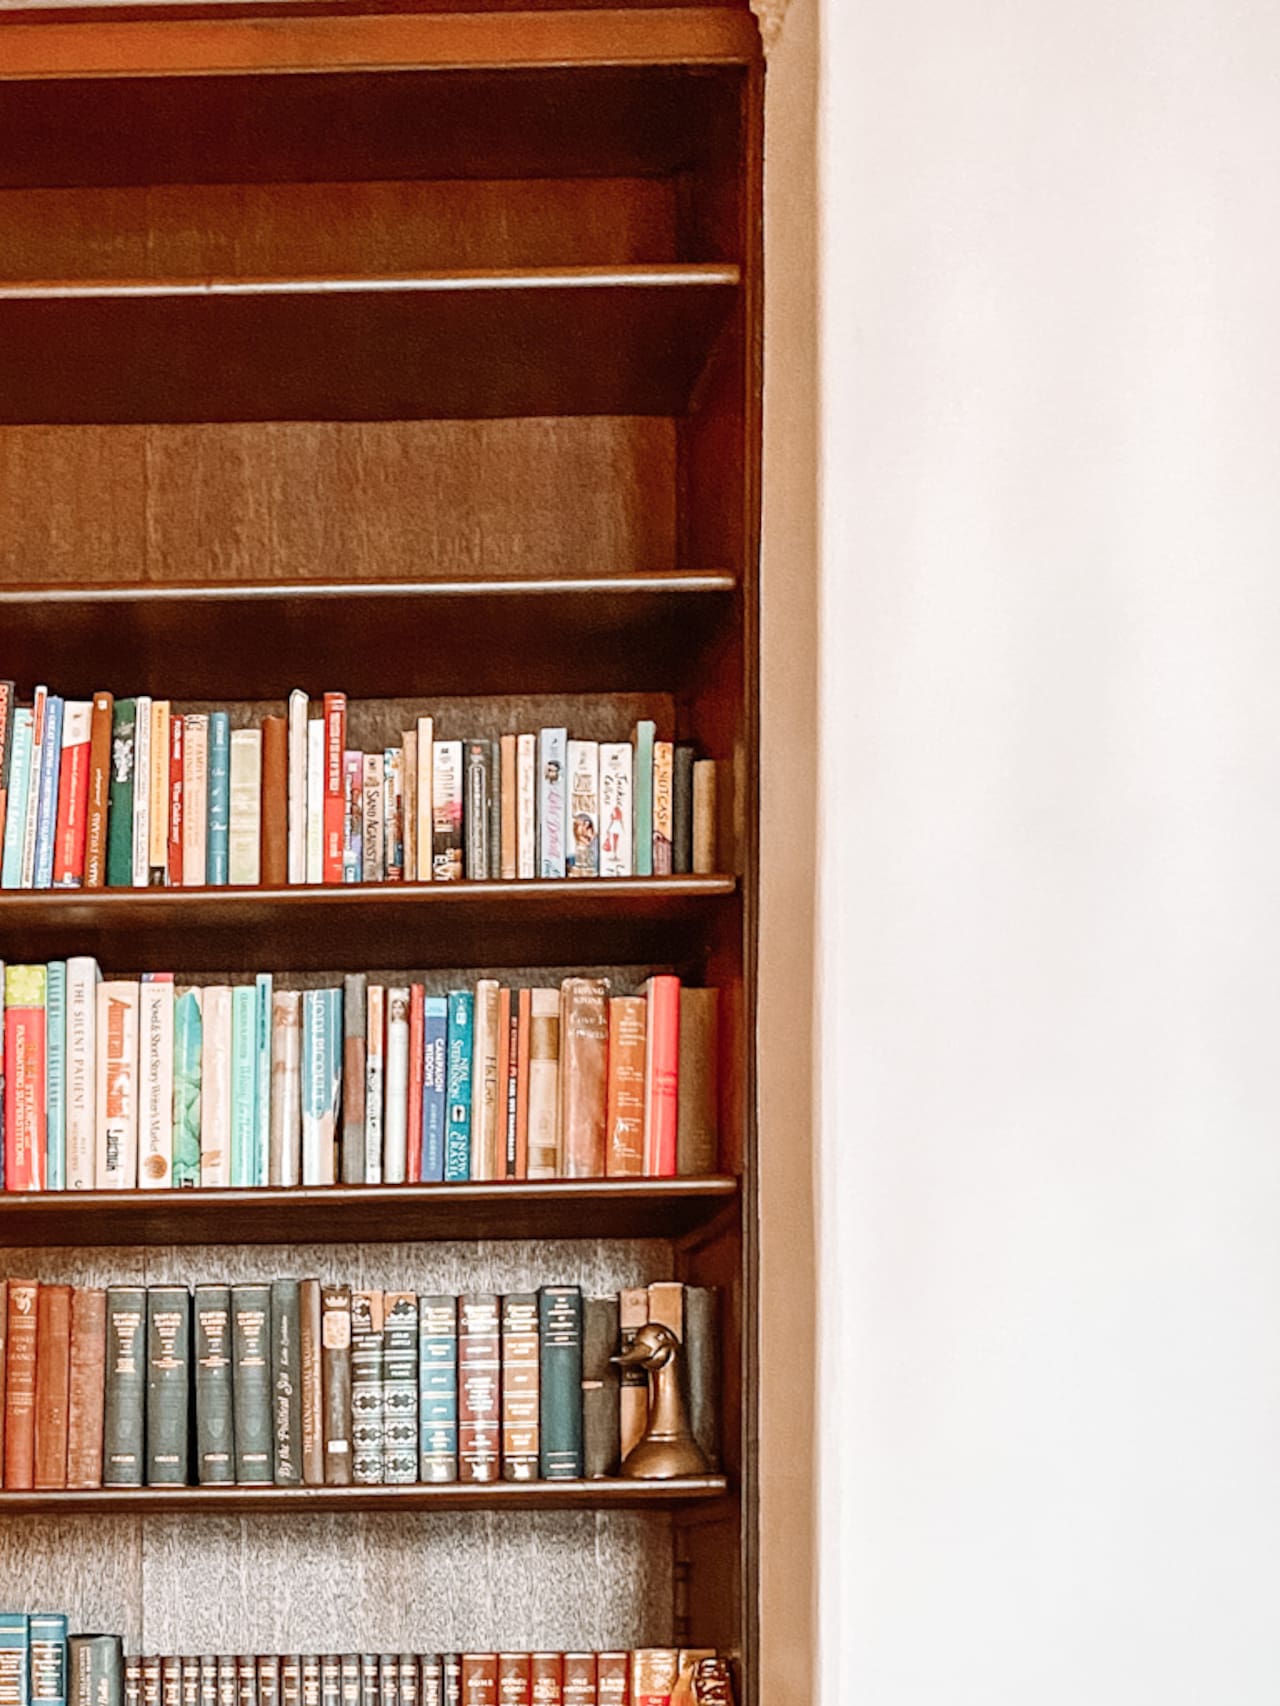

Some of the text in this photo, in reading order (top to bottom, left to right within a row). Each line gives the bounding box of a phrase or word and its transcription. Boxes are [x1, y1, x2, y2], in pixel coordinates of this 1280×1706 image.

[604, 775, 613, 805] Collins
[615, 773, 628, 807] Jackie
[658, 771, 669, 827] NUTCASE
[91, 812, 102, 854] DREAMS
[367, 790, 378, 864] SAND AGAINST
[150, 999, 161, 1024] Novel
[74, 982, 85, 1109] THE SILENT PATIENT
[107, 998, 131, 1118] American Mischief
[150, 1034, 161, 1058] Short
[312, 1000, 324, 1103] JODI PICOULT
[425, 1044, 434, 1087] WIDOWS
[435, 1038, 444, 1092] CAMPAIGN
[149, 1059, 161, 1083] Story
[450, 1040, 463, 1099] STEPHENSON
[460, 1057, 468, 1082] NEAL
[15, 1025, 25, 1166] FASCINATING SUPERSTITIONS
[25, 1084, 34, 1131] STRANGE
[150, 1085, 161, 1118] Writer's
[150, 1120, 161, 1152] Market
[448, 1131, 458, 1177] CRASH
[458, 1134, 467, 1174] SNOW
[277, 1396, 291, 1477] By the Political
[305, 1435, 313, 1454] THE
